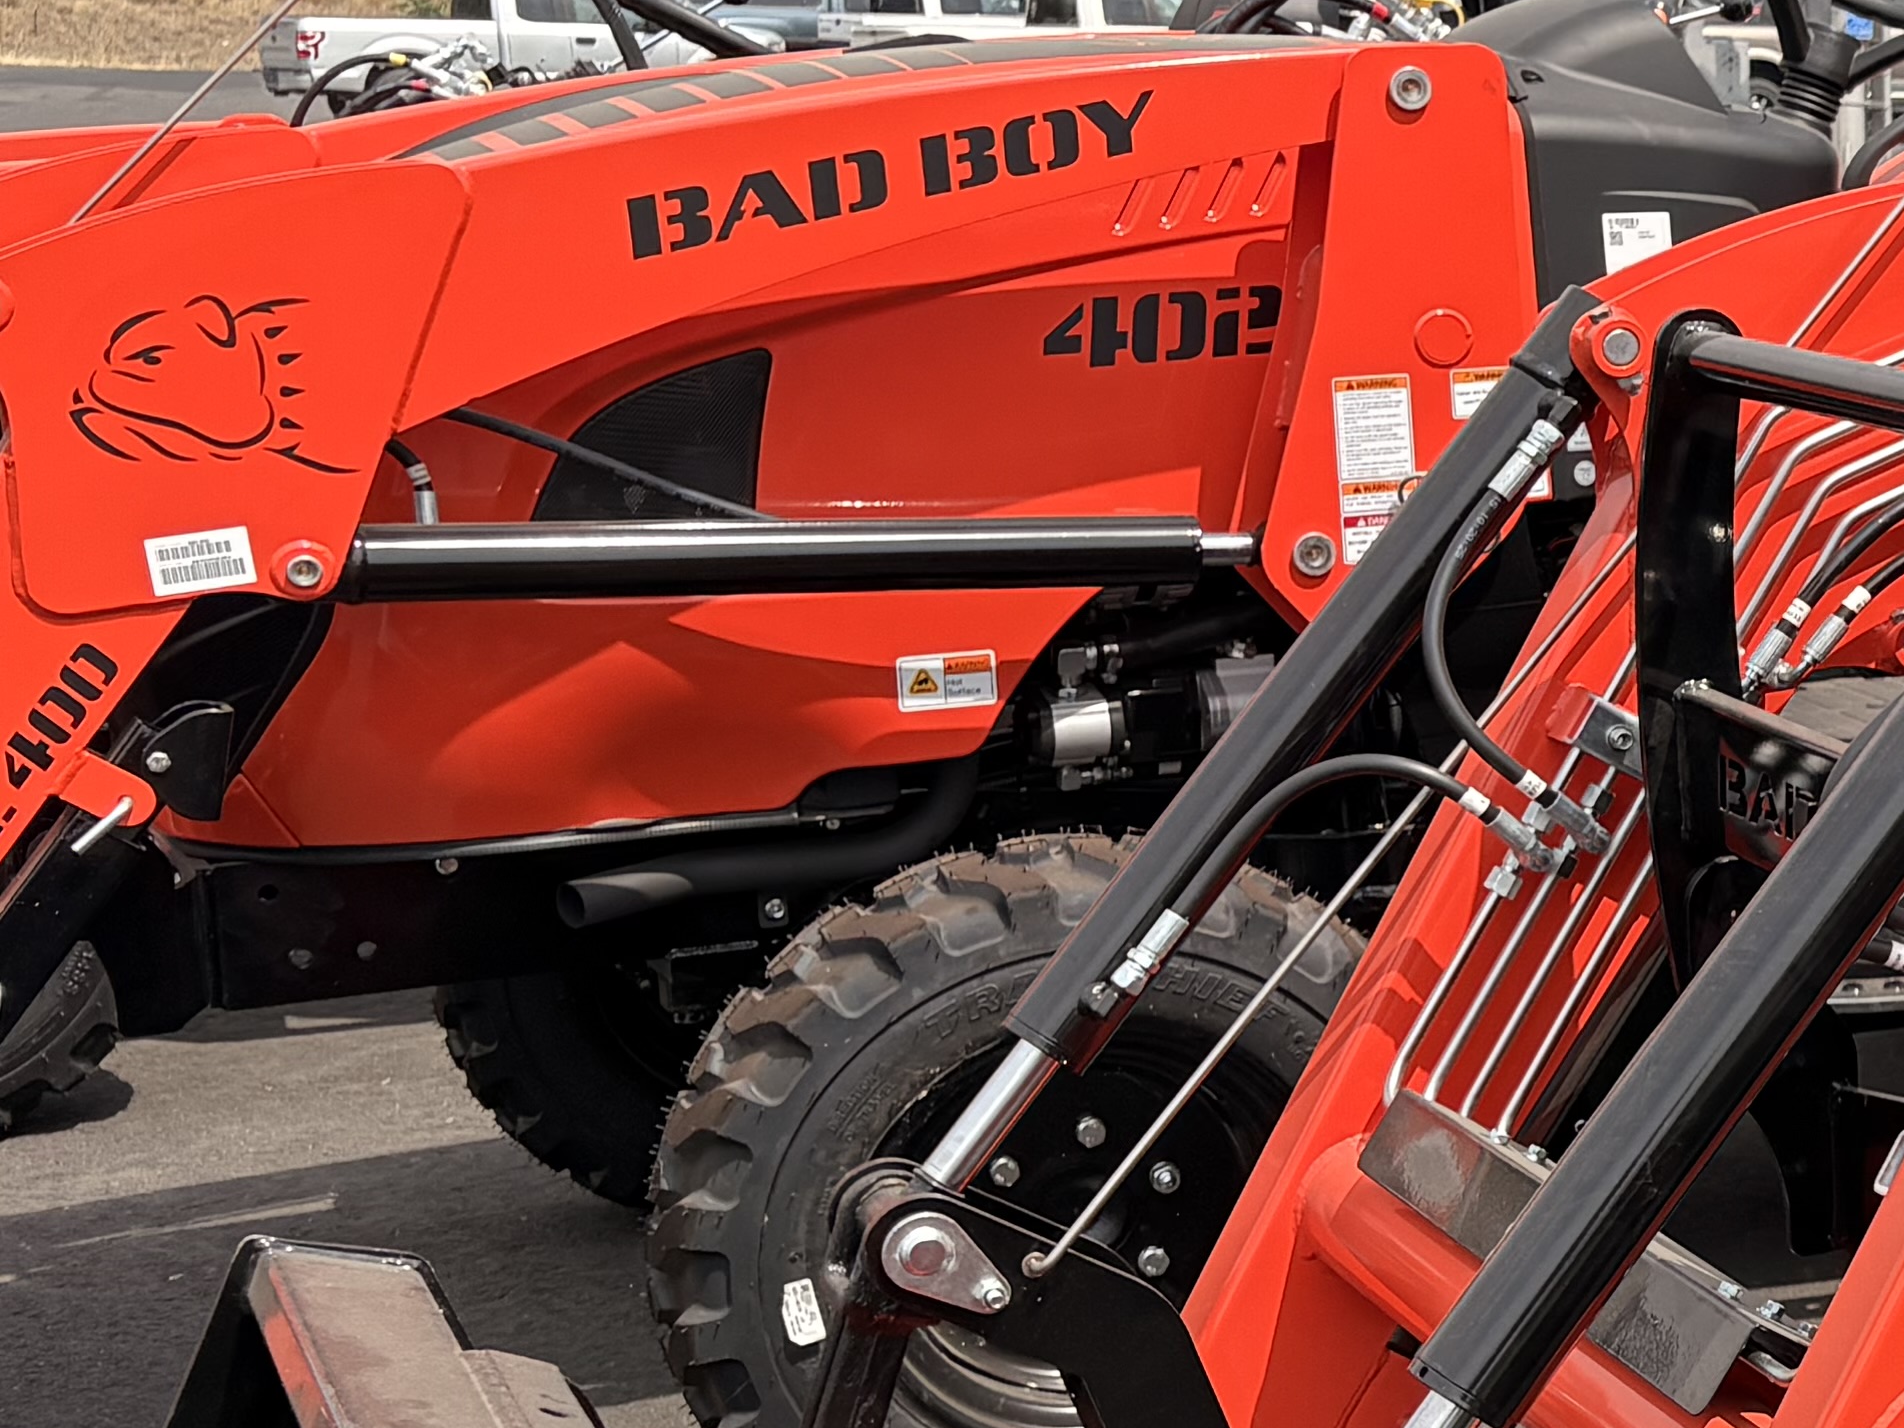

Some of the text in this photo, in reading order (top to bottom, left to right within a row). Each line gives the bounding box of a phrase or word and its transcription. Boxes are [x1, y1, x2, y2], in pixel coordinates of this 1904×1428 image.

[625, 87, 1156, 261] BAD BOY
[1042, 284, 1284, 369] 402
[2, 643, 119, 826] 400
